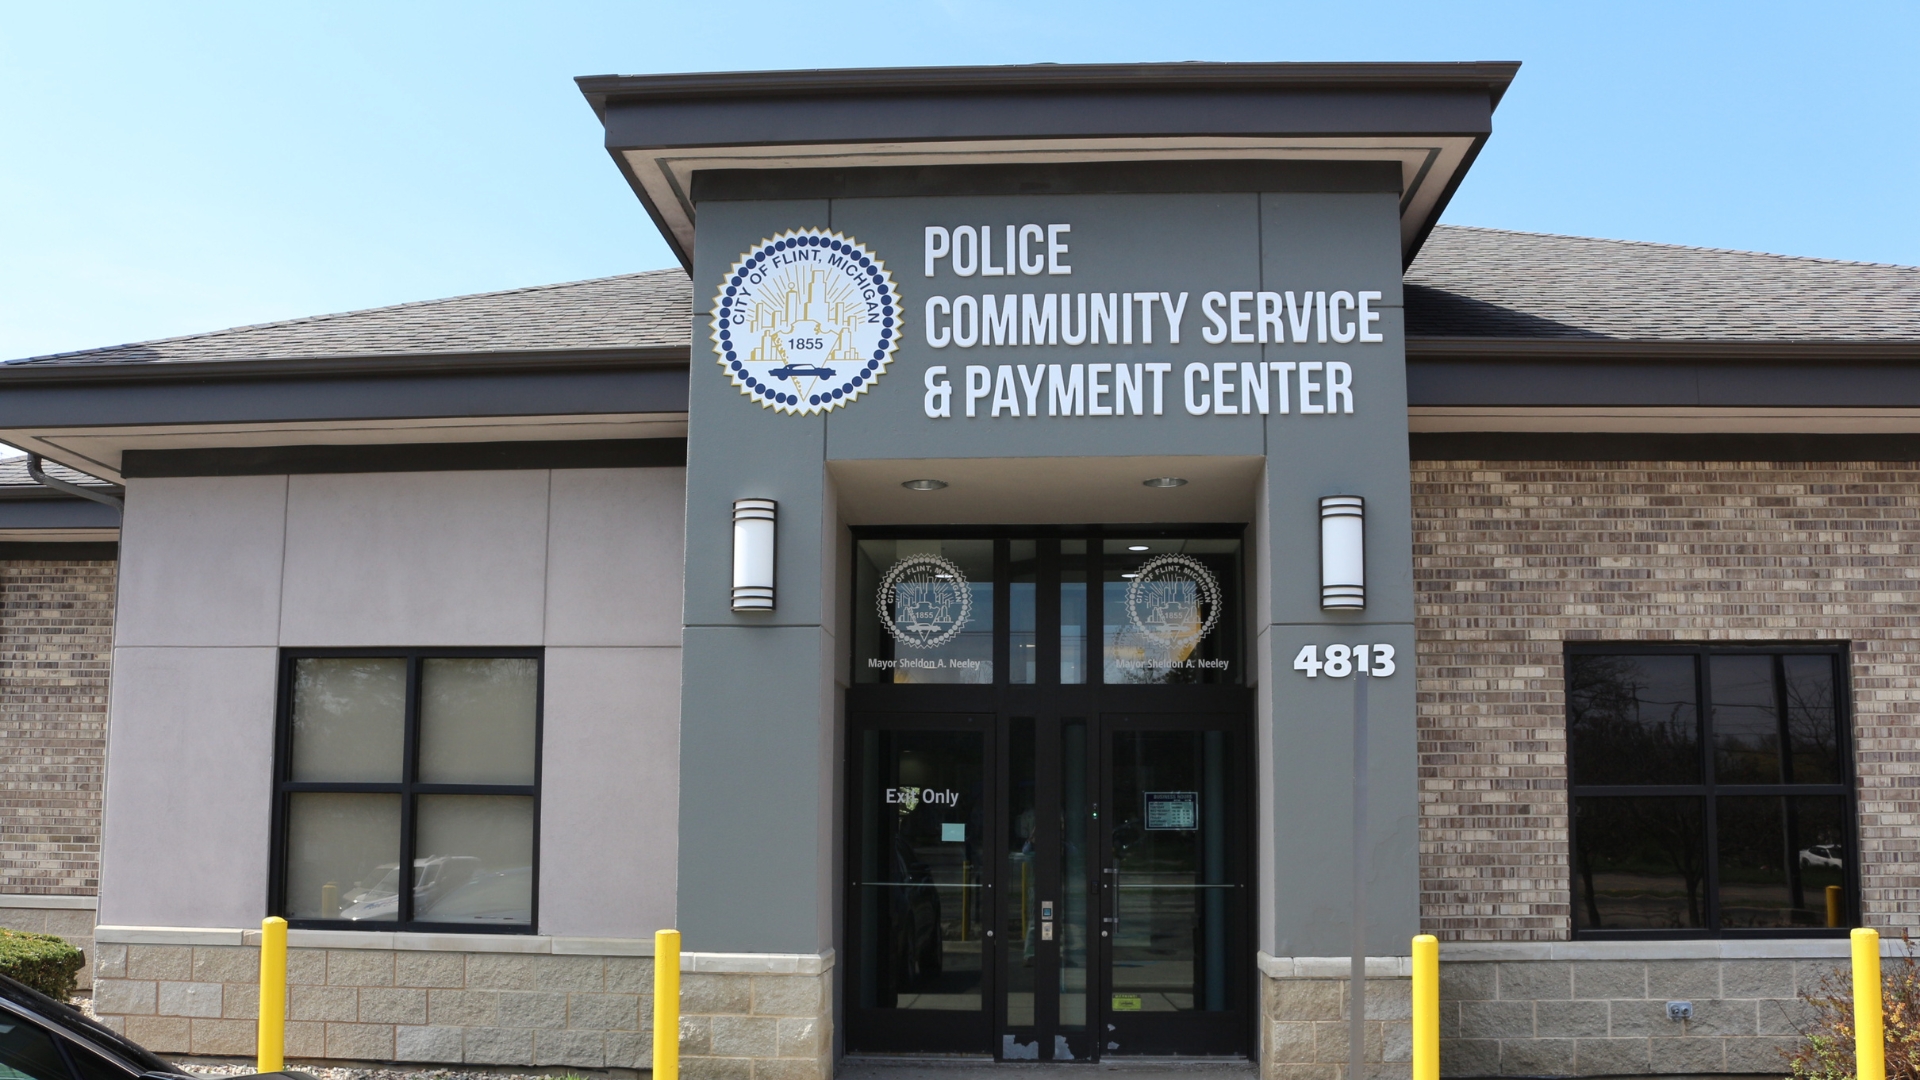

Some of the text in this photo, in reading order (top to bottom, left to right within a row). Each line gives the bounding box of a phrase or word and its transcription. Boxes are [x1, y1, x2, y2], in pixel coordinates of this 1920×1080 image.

[924, 223, 1072, 277] POLICE
[732, 249, 880, 325] CITY OF FLINT, MICHIGAN
[925, 290, 1384, 348] COMMUNITY SERVICE
[788, 338, 824, 350] 1855
[924, 361, 1354, 418] & PAYMENT CENTER
[887, 583, 898, 604] CITY
[896, 572, 906, 583] OF
[1135, 585, 1146, 604] CITY
[1144, 573, 1154, 583] OF
[1183, 567, 1211, 603] MICHIGAN
[915, 611, 933, 619] 1855
[868, 658, 981, 671] Mayor Sheldon A. Neeley
[1116, 658, 1229, 671] Mayor Sheldon A. Neeley
[1293, 643, 1396, 678] 4813
[886, 788, 959, 807] Exit Only
